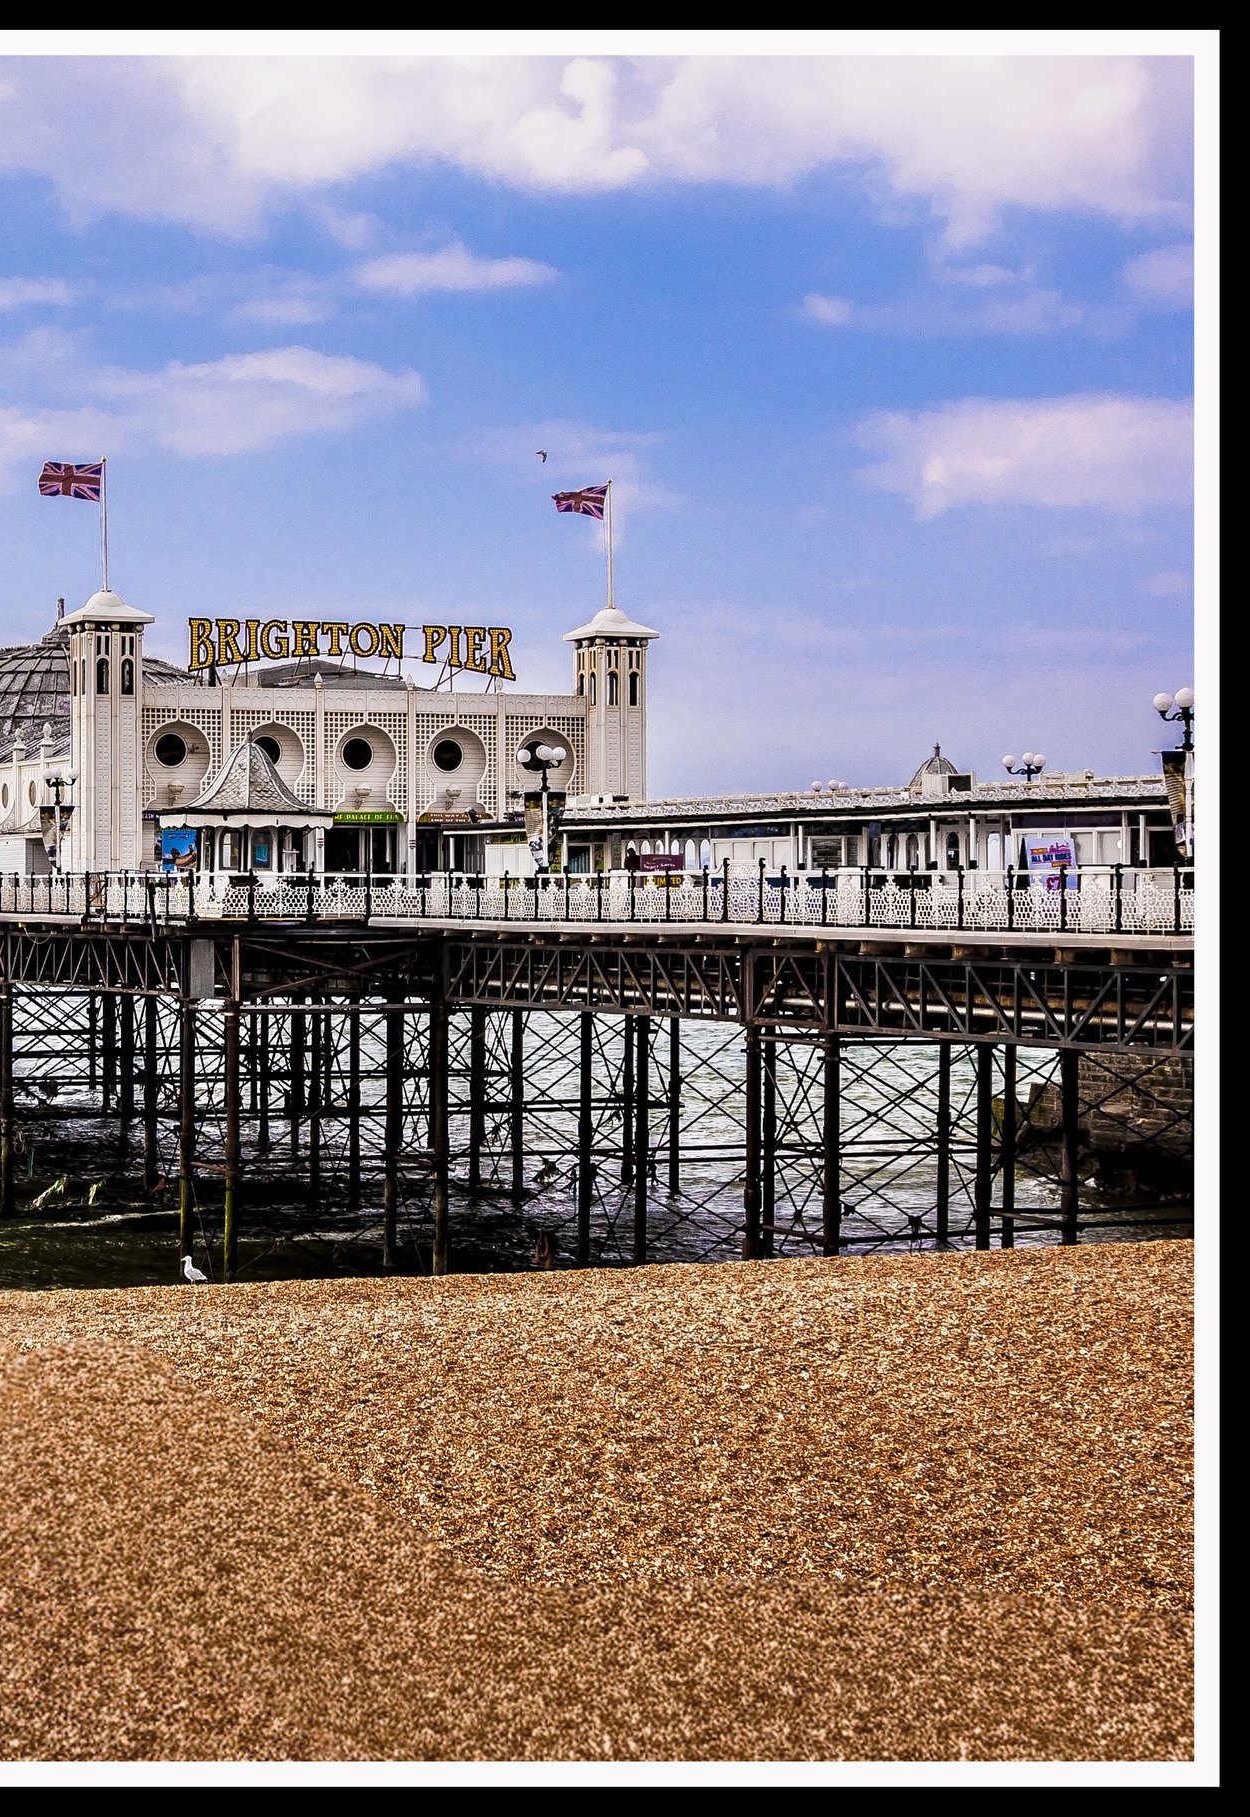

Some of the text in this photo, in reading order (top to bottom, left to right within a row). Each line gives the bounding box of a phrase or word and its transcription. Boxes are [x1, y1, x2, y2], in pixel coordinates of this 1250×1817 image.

[188, 617, 516, 681] BRIGHTON PIER
[1031, 855, 1042, 863] ALL
